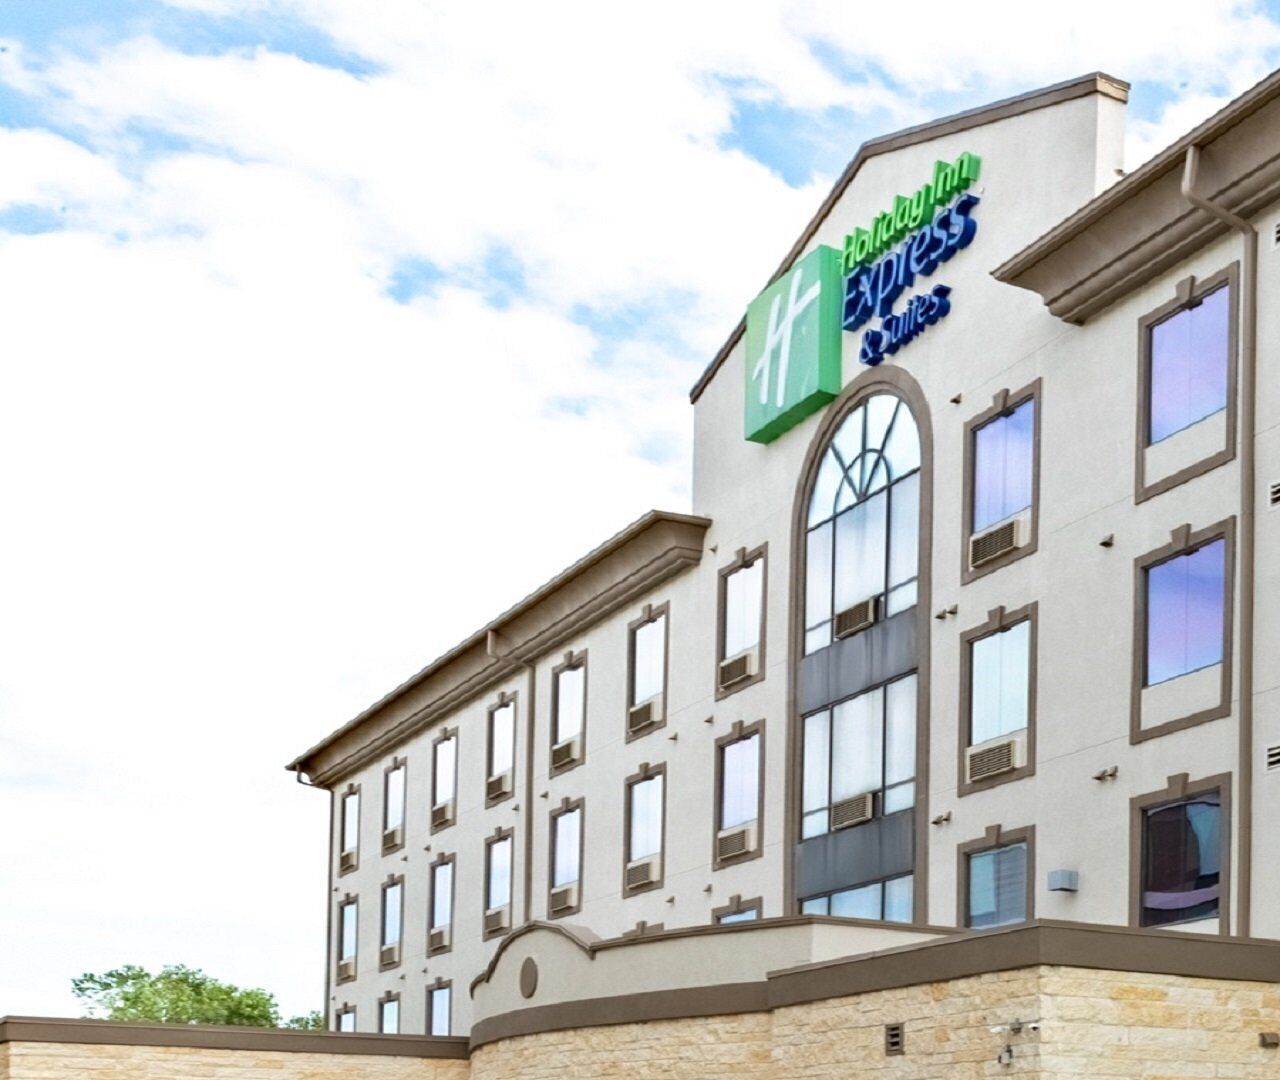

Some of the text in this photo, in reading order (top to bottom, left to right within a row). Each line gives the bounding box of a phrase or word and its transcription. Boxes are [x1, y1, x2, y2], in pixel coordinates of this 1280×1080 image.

[842, 152, 982, 272] Holiday Inn
[842, 194, 980, 332] Express
[859, 284, 952, 366] & Suites
